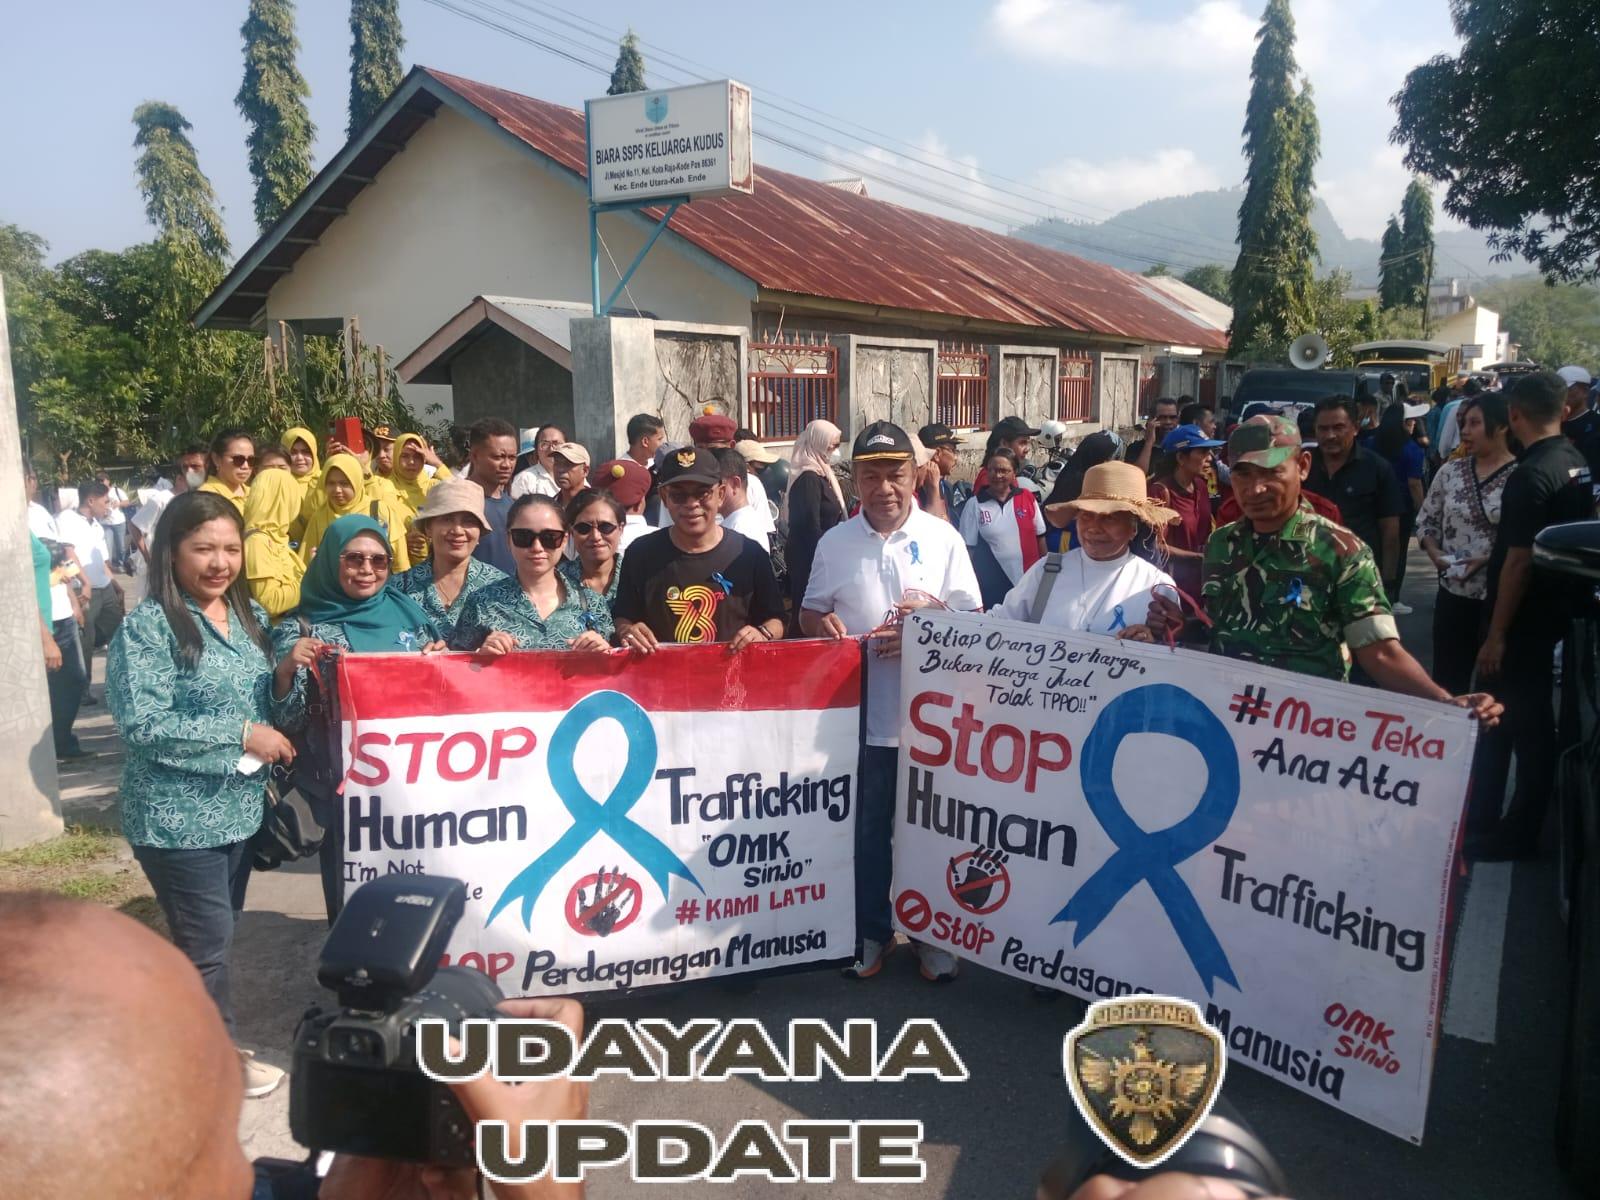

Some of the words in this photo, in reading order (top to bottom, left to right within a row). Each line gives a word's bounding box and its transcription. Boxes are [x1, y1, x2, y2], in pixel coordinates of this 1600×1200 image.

[595, 146, 621, 165] BIARA
[622, 143, 644, 162] SSPS
[645, 137, 692, 159] KELUARGA
[693, 132, 724, 150] KUDUS
[630, 180, 648, 190] Ende
[688, 173, 706, 183] Ende
[919, 650, 983, 673] Bukan
[987, 656, 1040, 688] Harga
[1046, 665, 1095, 689] Jual
[985, 631, 1047, 666] Orang
[986, 684, 1034, 707] Tolak
[347, 726, 537, 787] STOP
[1365, 710, 1445, 760] Teka
[655, 767, 851, 826] Trafficking
[1252, 737, 1330, 785] Ana
[1337, 755, 1420, 807] Ata
[347, 795, 527, 852] Human
[906, 766, 1079, 867] Human
[387, 859, 425, 876] Not
[769, 883, 826, 911] LATU
[1213, 844, 1426, 972] Trafficking
[522, 947, 721, 991] Perdagangan
[724, 930, 827, 967] Manusia
[1001, 936, 1155, 998] Perdagan
[1206, 1002, 1345, 1101] Manusia
[1323, 1003, 1395, 1050] OMK
